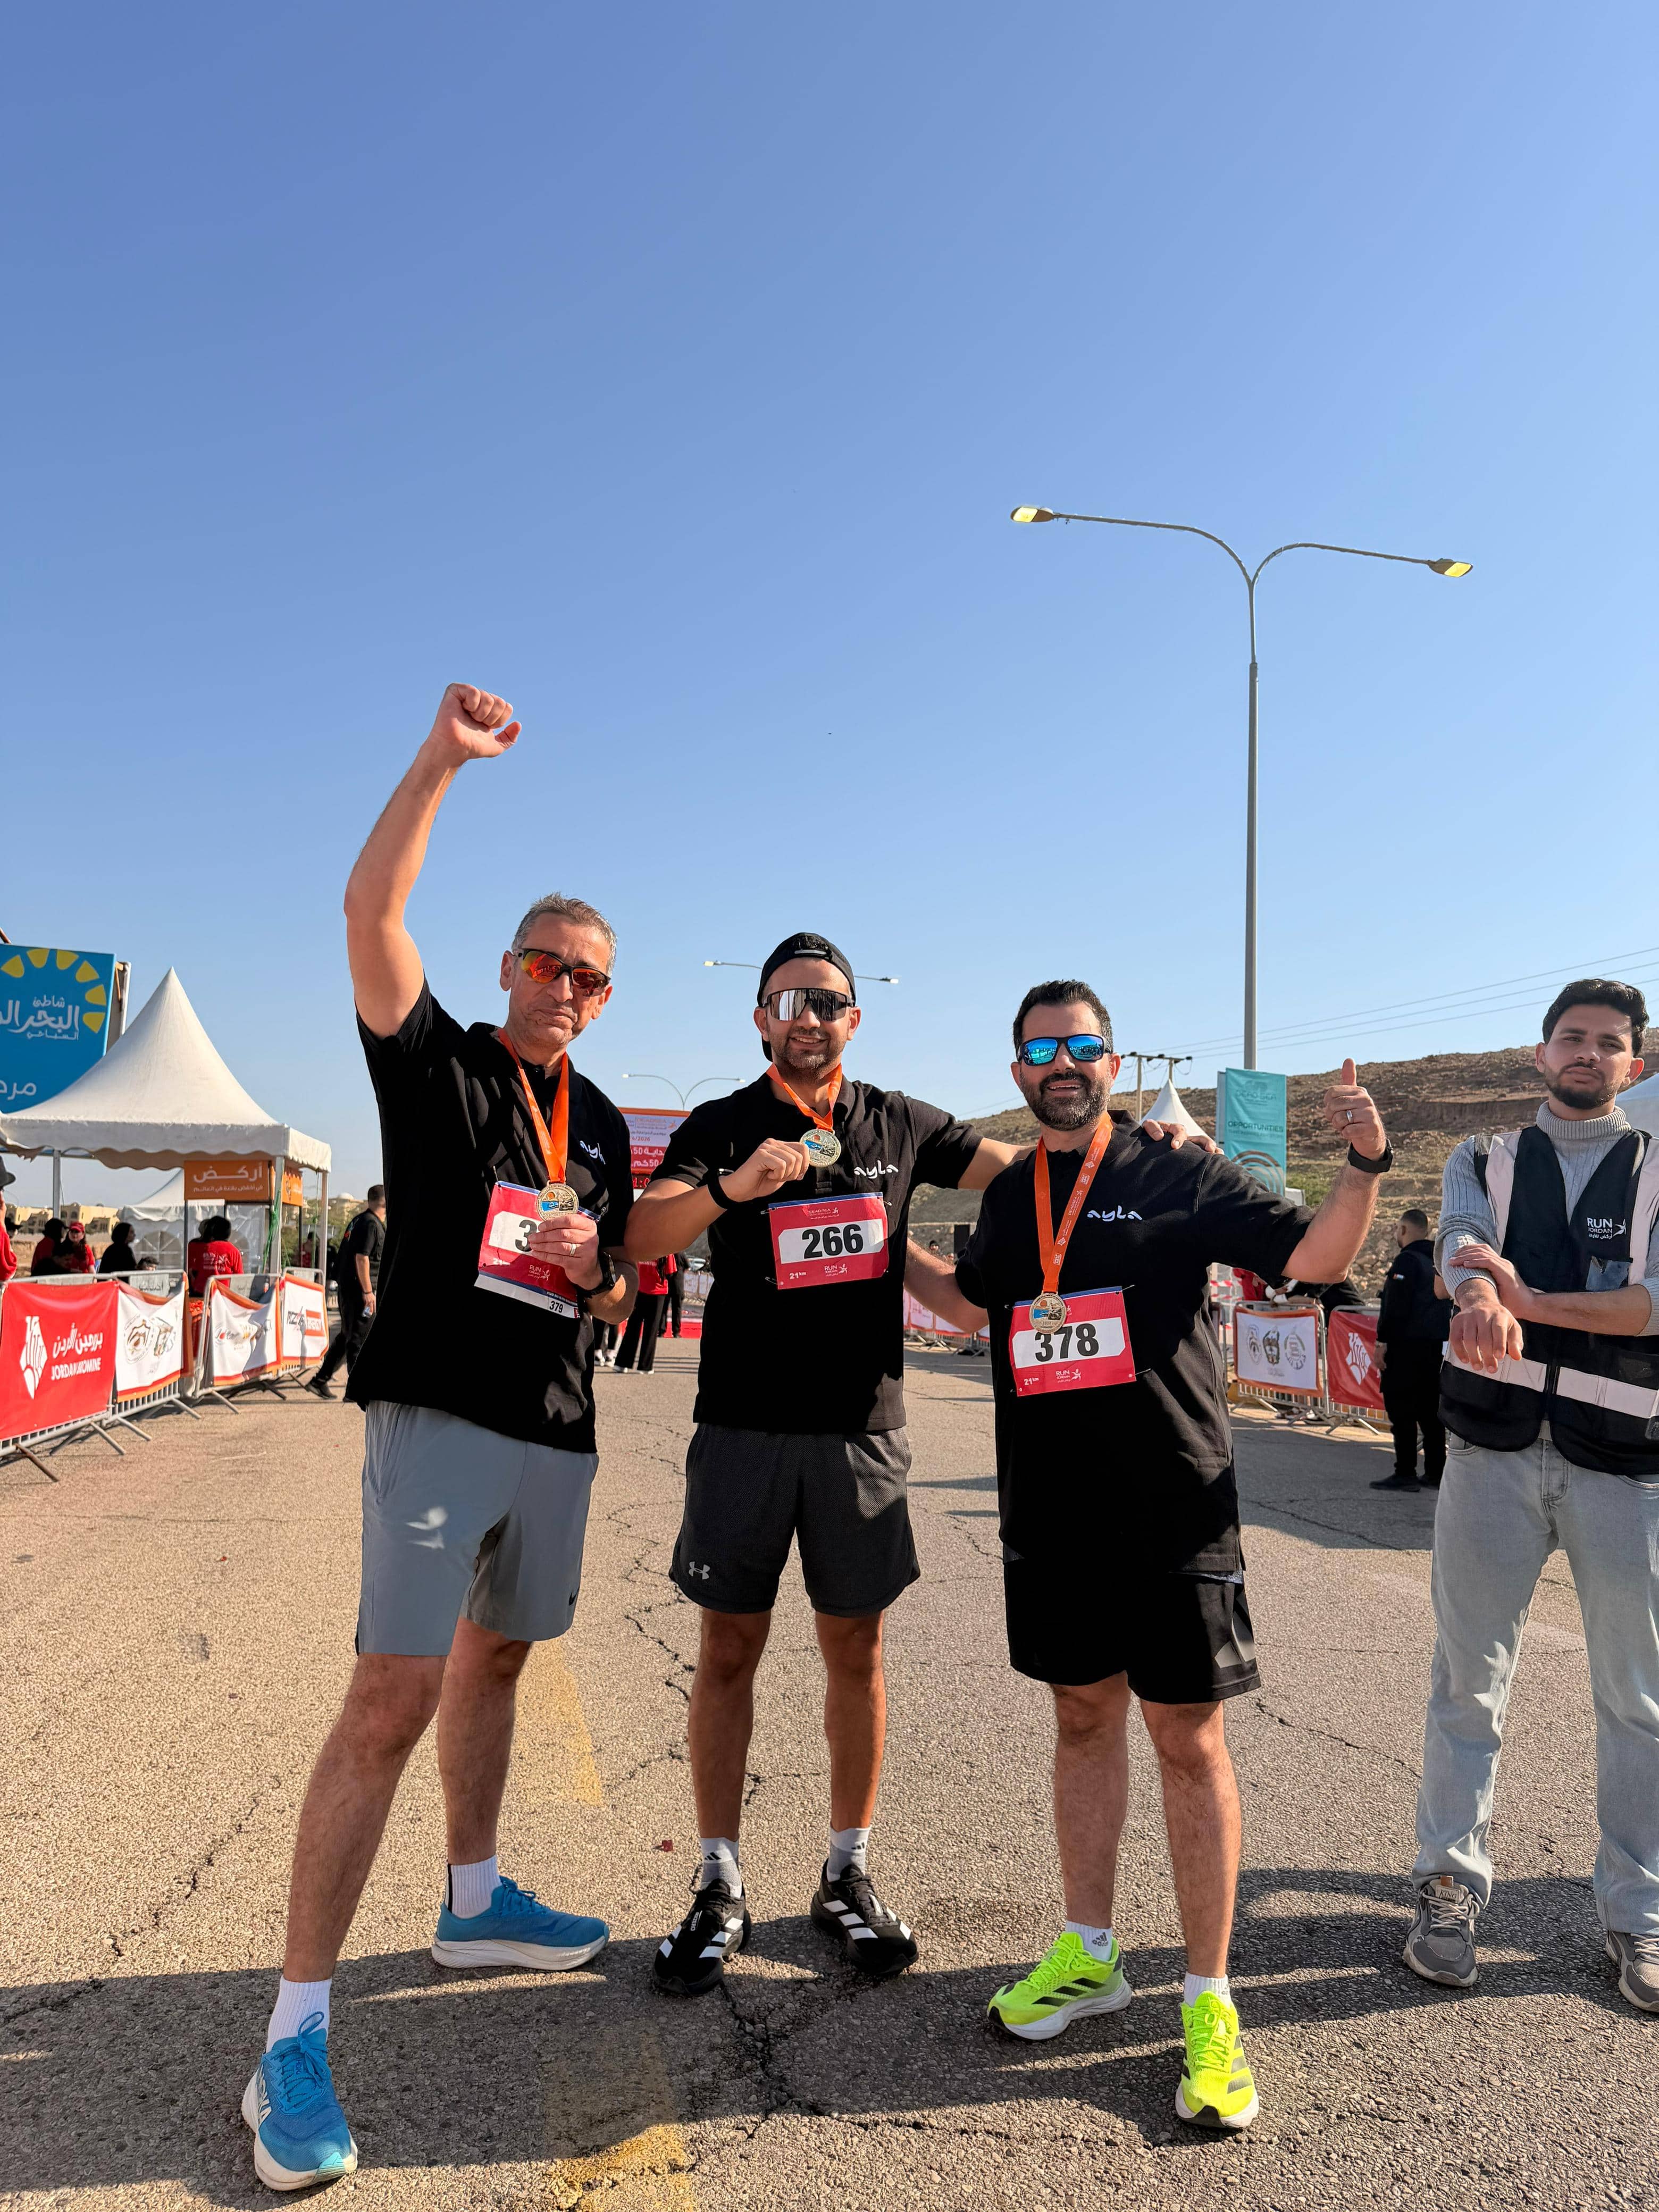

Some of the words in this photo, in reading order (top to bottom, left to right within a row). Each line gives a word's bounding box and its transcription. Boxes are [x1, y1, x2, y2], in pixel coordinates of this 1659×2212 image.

[1228, 1120, 1284, 1132] OPPORTUNITIES
[854, 1160, 899, 1179] ayla
[1087, 1205, 1143, 1222] ayla
[1587, 1217, 1613, 1228] RUN
[802, 1224, 864, 1259] 266
[549, 1301, 564, 1313] 379
[1035, 1323, 1099, 1362] 378
[1439, 1889, 1457, 1899] KING
